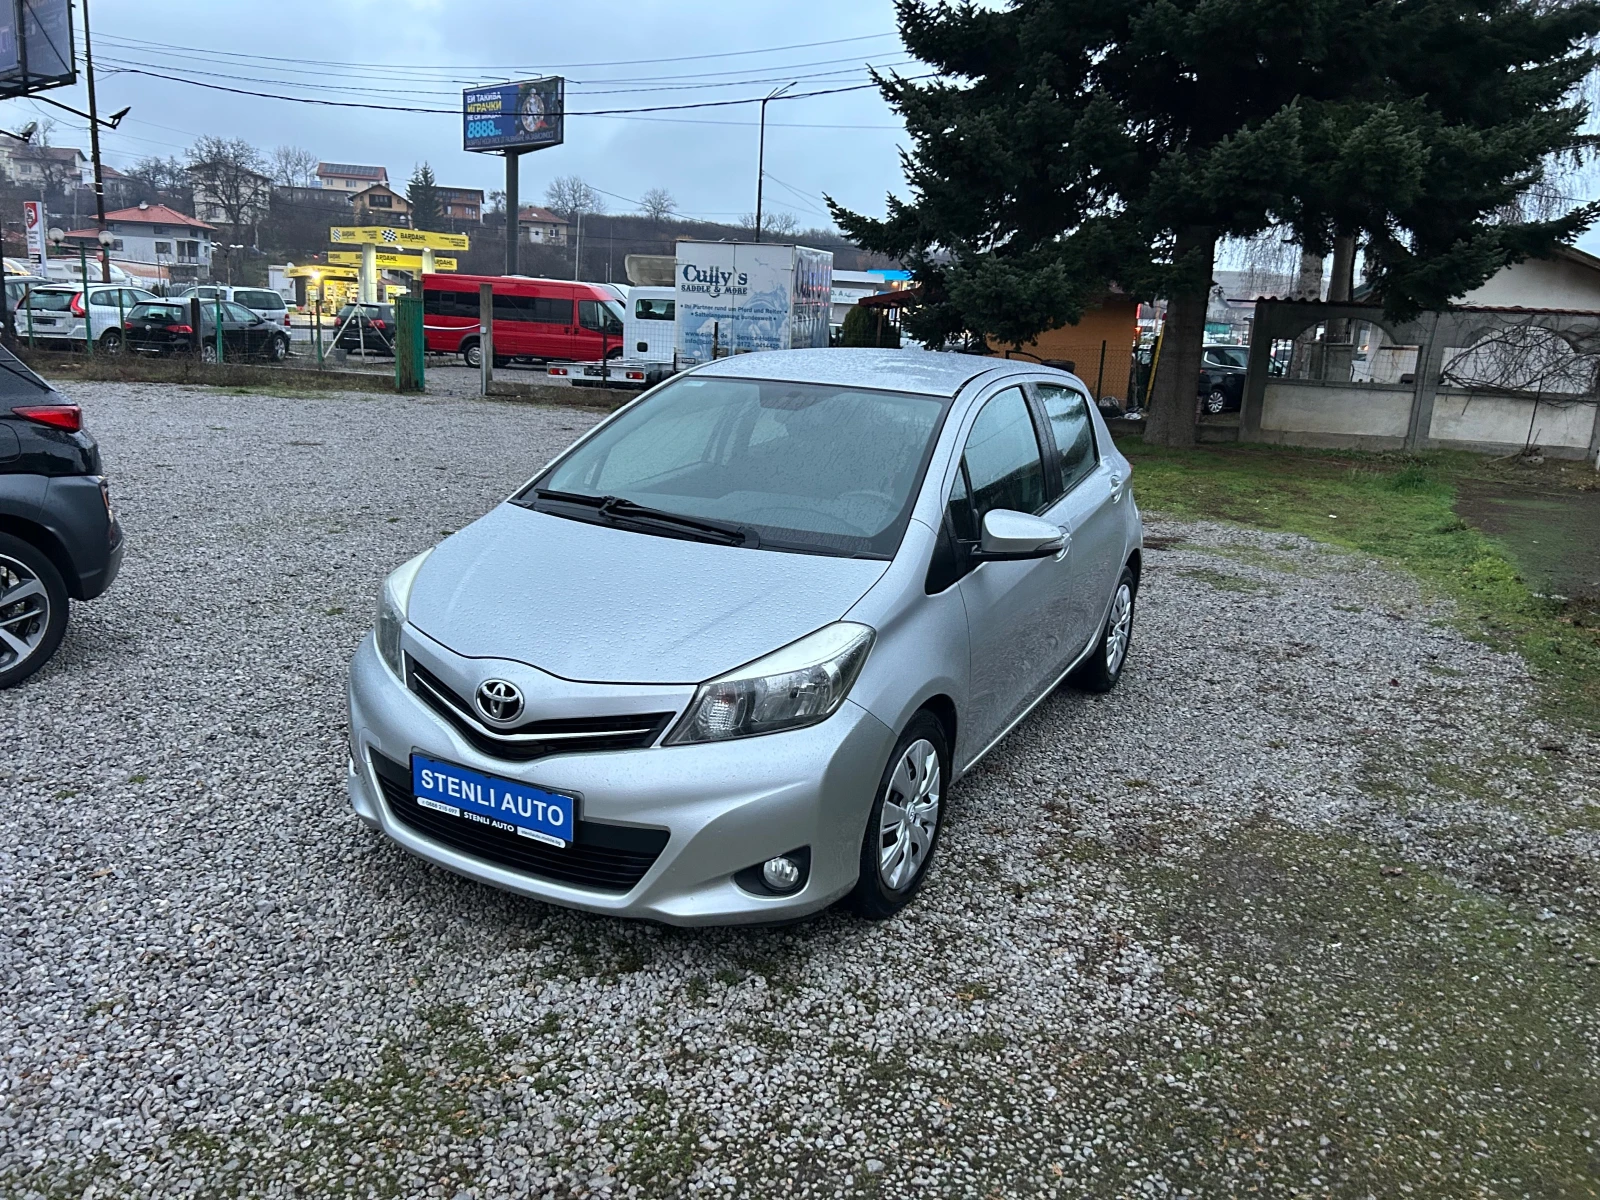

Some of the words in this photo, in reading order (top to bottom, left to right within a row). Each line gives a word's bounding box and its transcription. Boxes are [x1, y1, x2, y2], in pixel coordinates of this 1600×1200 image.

[467, 101, 502, 113] ИГРАЧКИ
[400, 232, 427, 242] BARDAHL
[375, 254, 398, 264] ARDAHL
[681, 284, 711, 293] SADDLE
[725, 286, 748, 295] MORE
[421, 769, 496, 808] STENLI
[501, 793, 564, 826] AUTO
[463, 811, 490, 825] STENLI
[491, 820, 515, 832] AUTO
